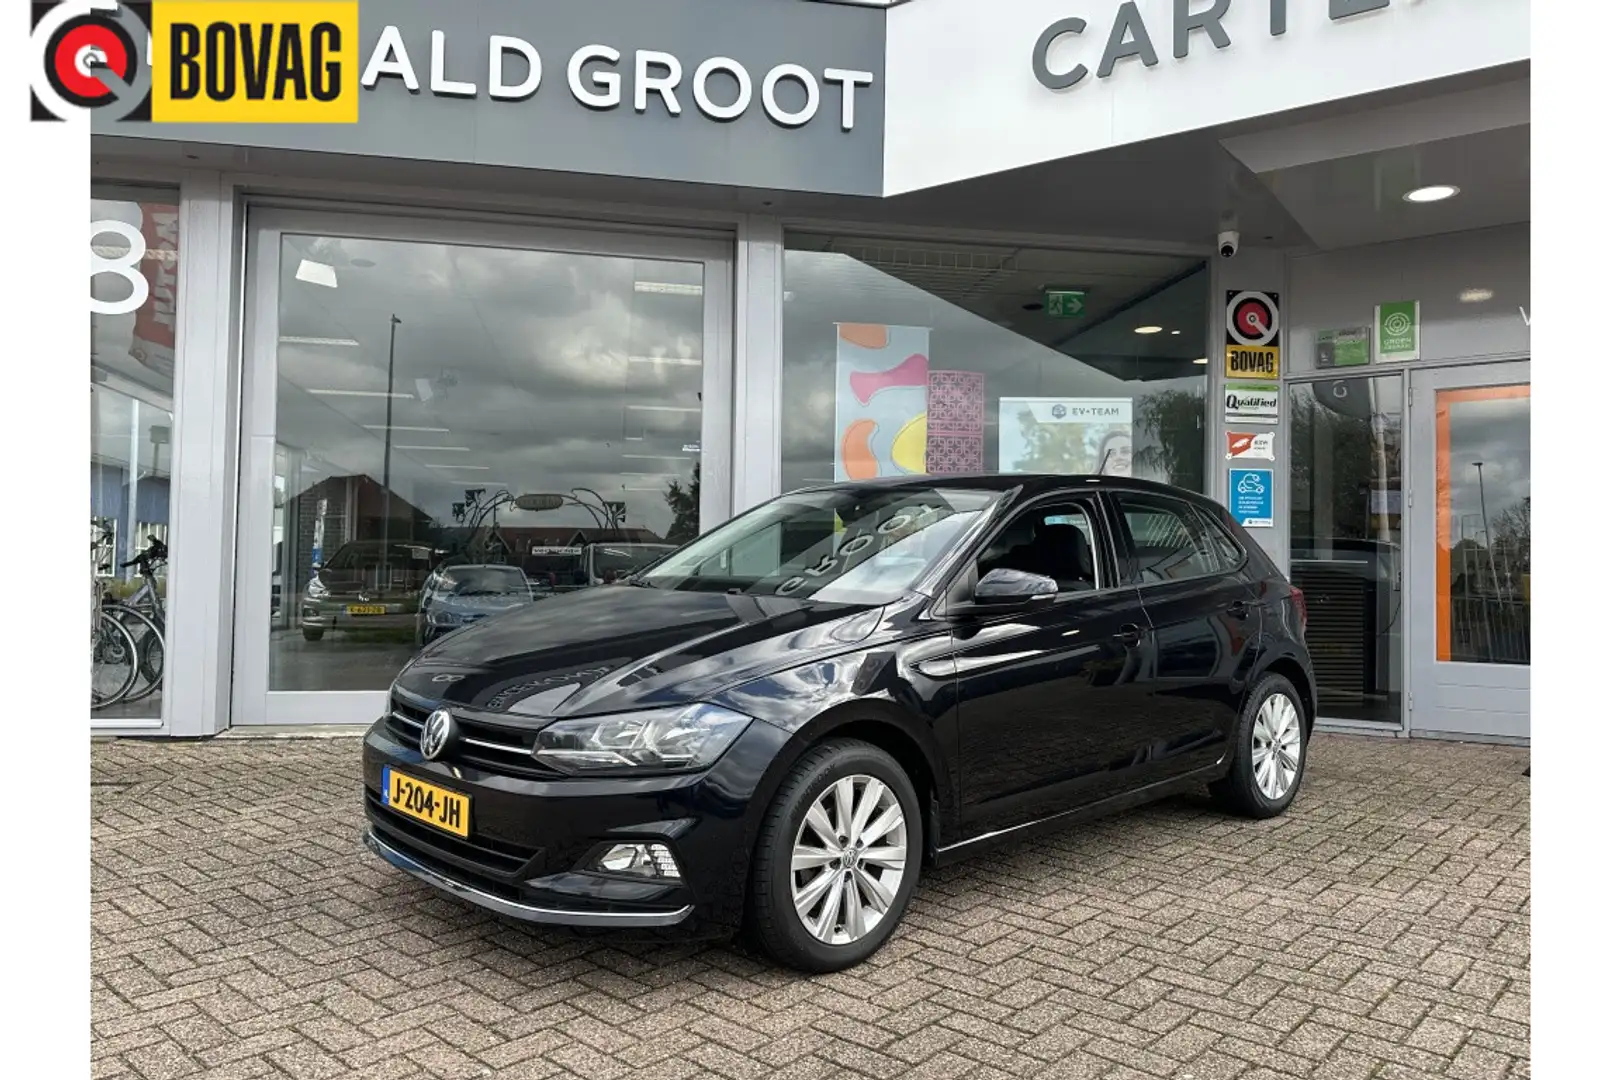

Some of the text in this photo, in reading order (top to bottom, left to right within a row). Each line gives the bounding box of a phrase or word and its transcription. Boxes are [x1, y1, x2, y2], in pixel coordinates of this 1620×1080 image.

[360, 25, 874, 131] ALD GROOT
[1230, 350, 1274, 373] BOVAG
[1226, 394, 1277, 410] Qualified
[392, 777, 462, 829] J-204-JH
